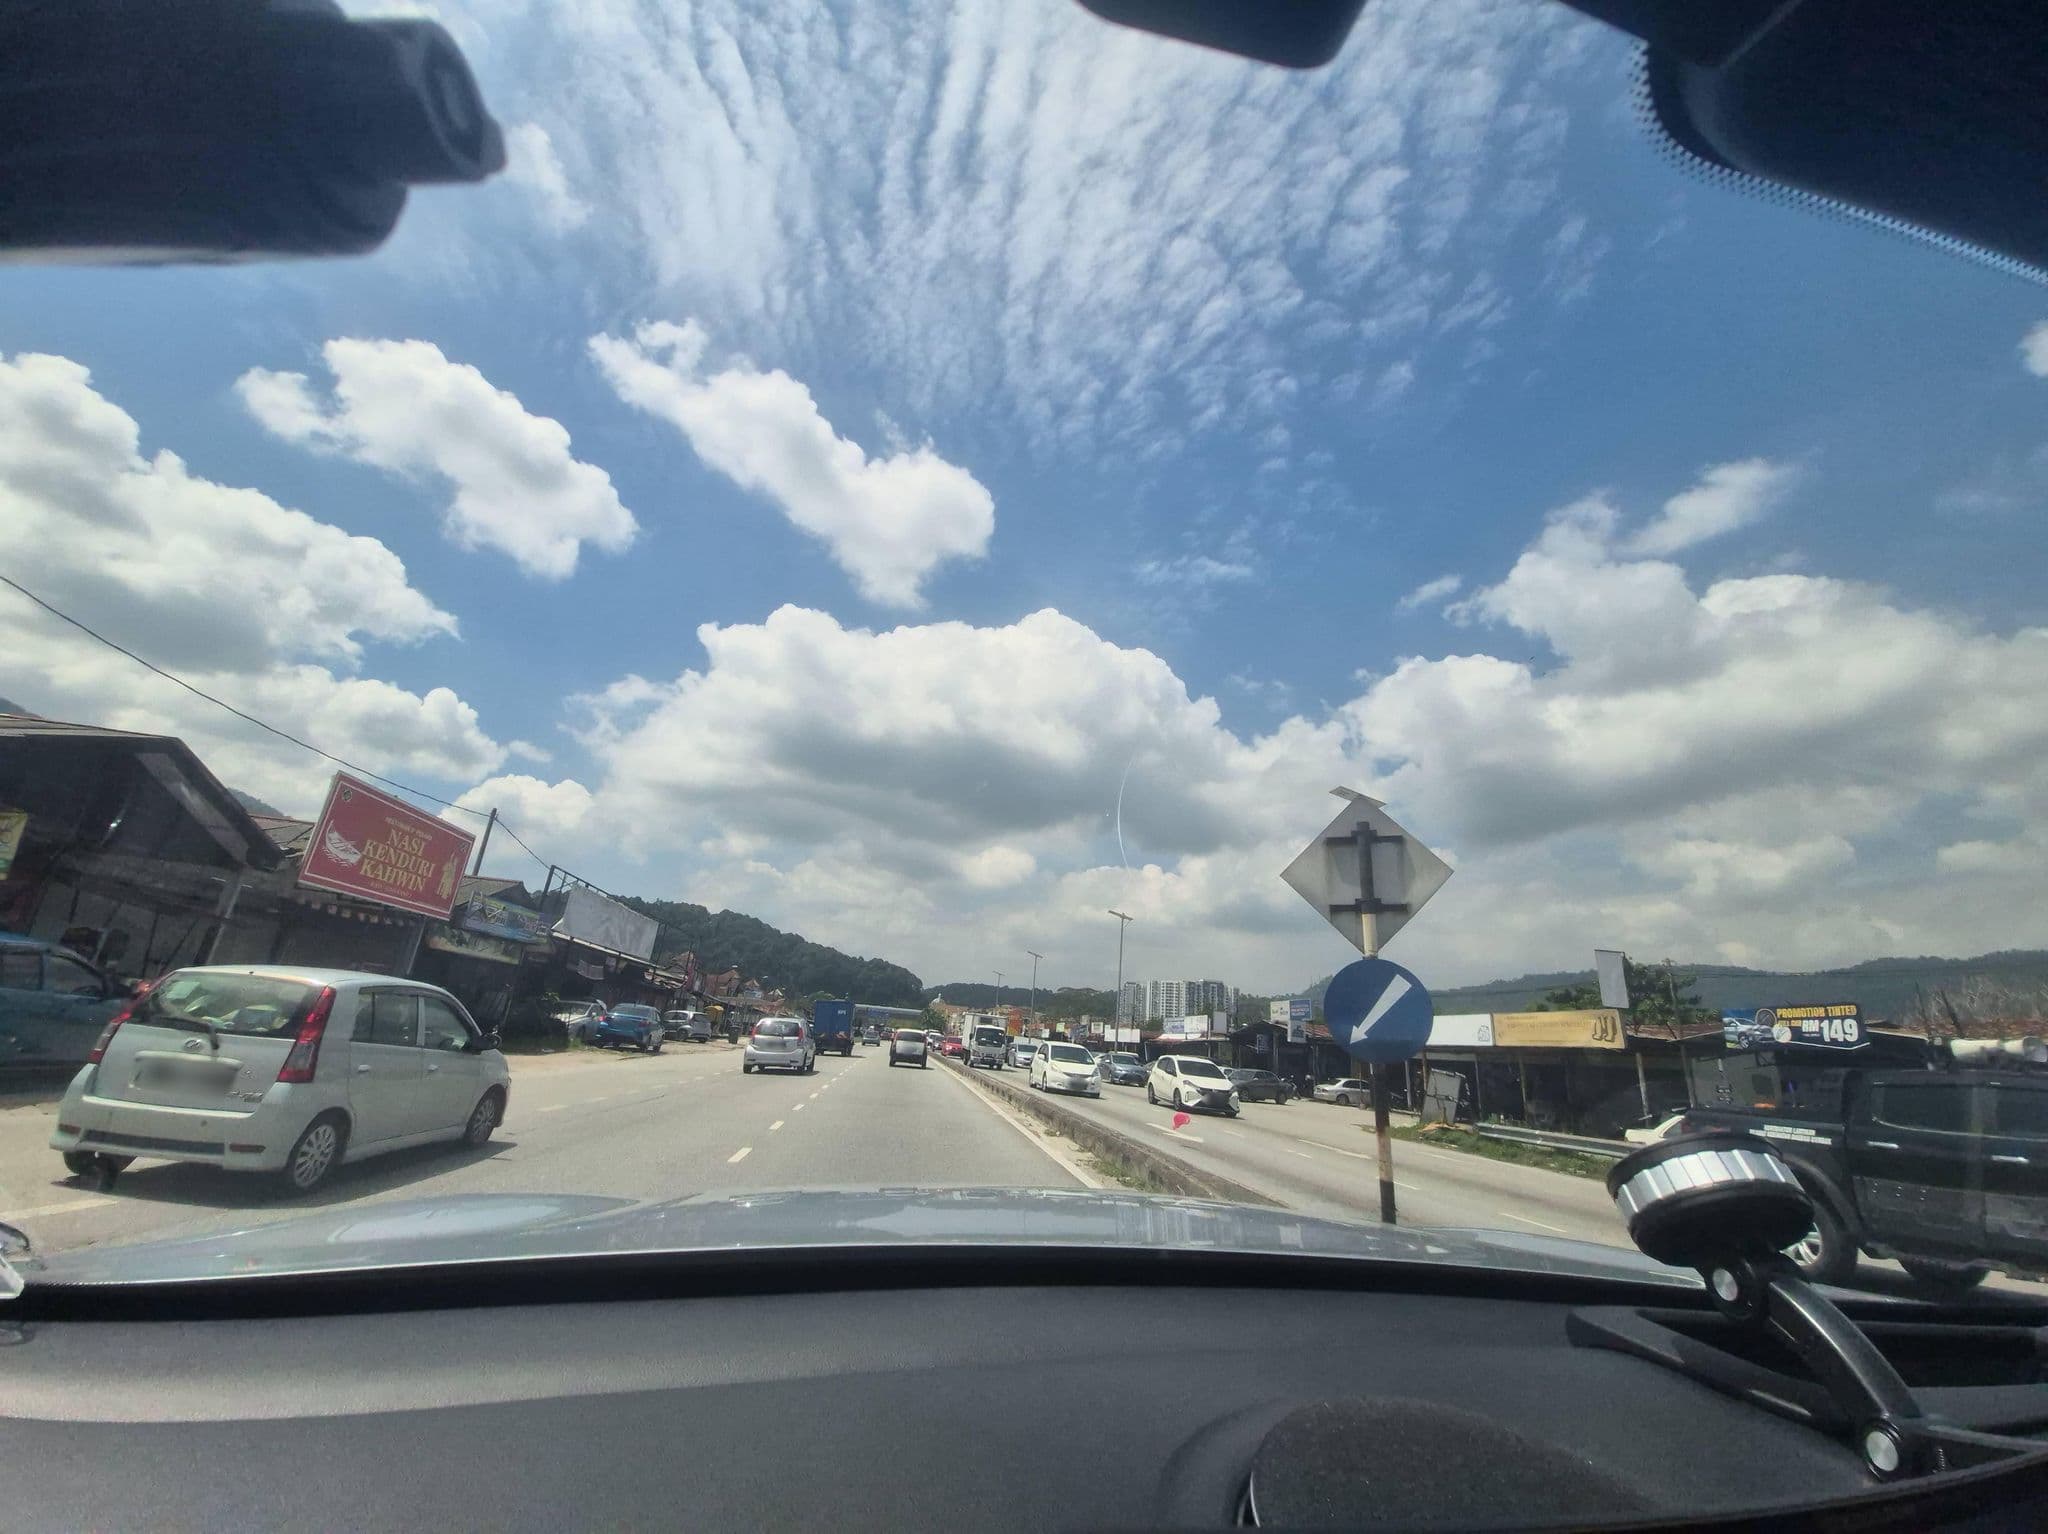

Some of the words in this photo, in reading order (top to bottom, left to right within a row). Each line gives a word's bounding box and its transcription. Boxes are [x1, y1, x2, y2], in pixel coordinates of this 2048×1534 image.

[387, 829, 426, 857] NASI
[363, 839, 436, 878] KENDURI
[360, 859, 428, 892] KAHWIN
[1777, 1007, 1825, 1018] PROMOTION
[1826, 1005, 1857, 1016] TINTED
[1802, 1019, 1820, 1032] RM
[1820, 1018, 1859, 1042] 149
